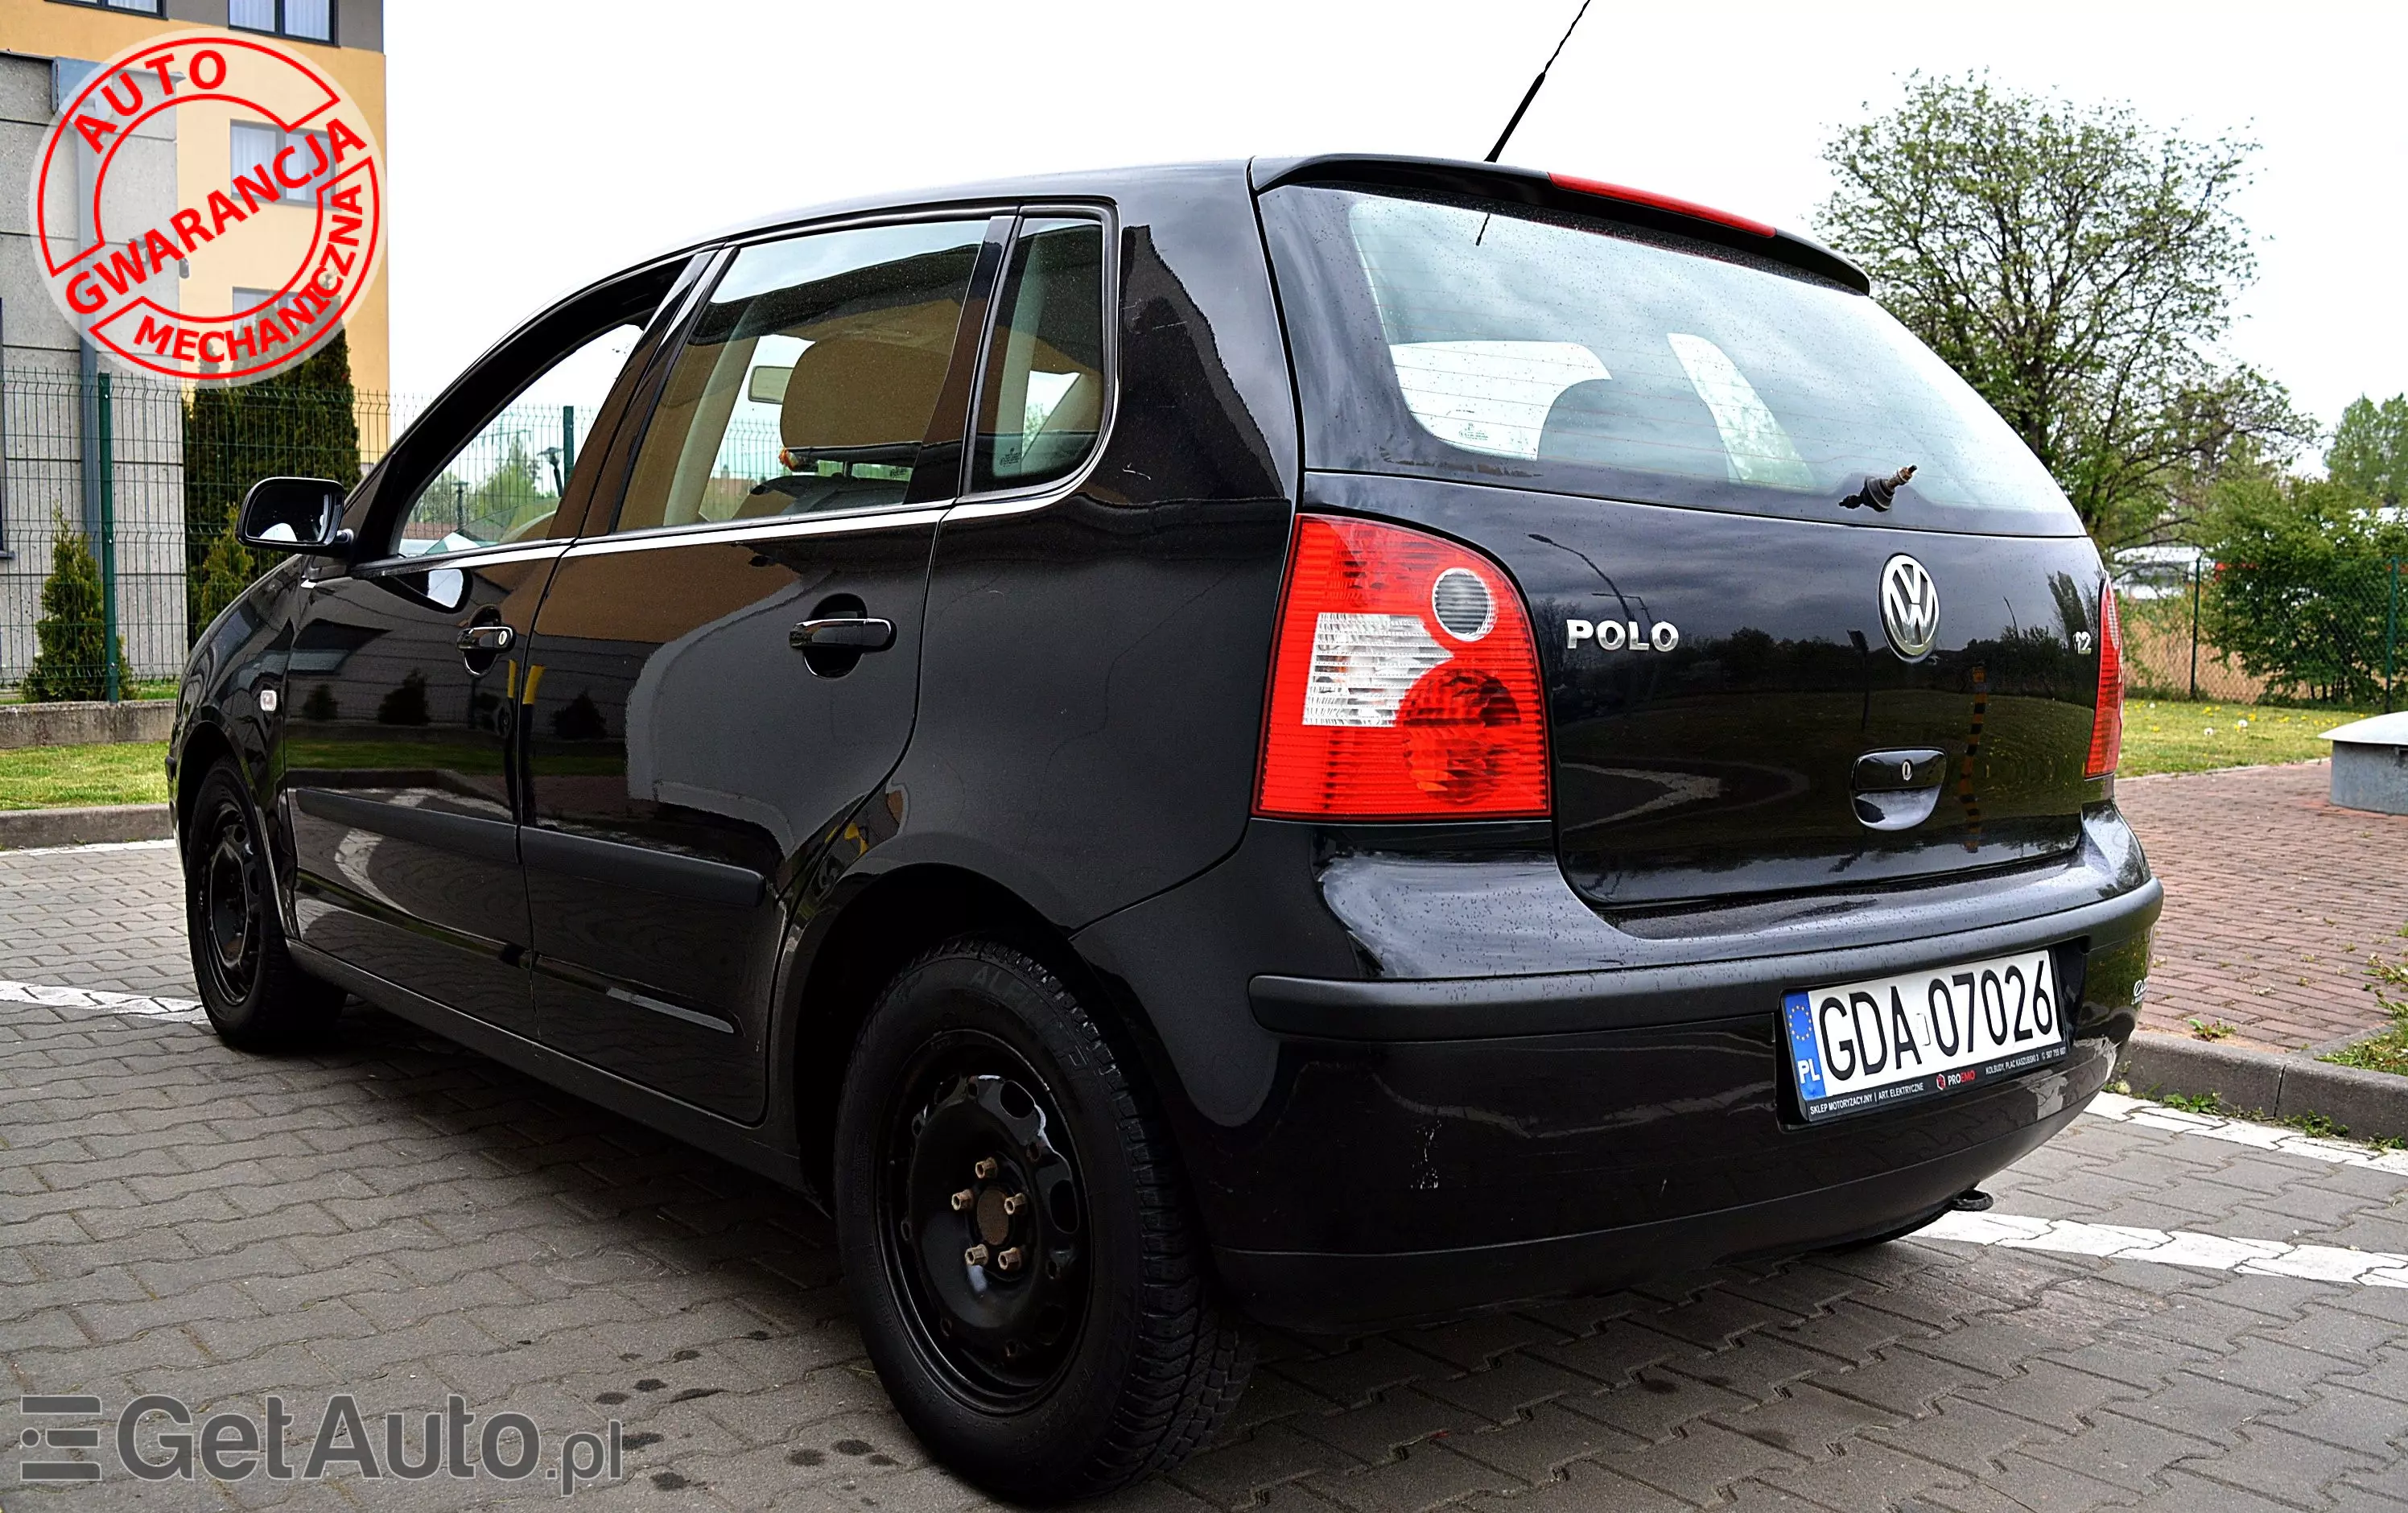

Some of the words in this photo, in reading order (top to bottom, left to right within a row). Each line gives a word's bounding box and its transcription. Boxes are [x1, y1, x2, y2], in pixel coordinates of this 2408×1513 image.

[1566, 619, 1680, 653] POLO
[1819, 985, 1922, 1081] GDA
[1928, 960, 2053, 1057] 07026
[1797, 1059, 1820, 1084] PL
[1947, 1070, 1977, 1086] PROEMO
[1810, 1103, 1828, 1115] SKLEP
[1828, 1094, 1873, 1111] MOTORYZACYJNY
[1889, 1082, 1924, 1098] ELEKTRYCZNE
